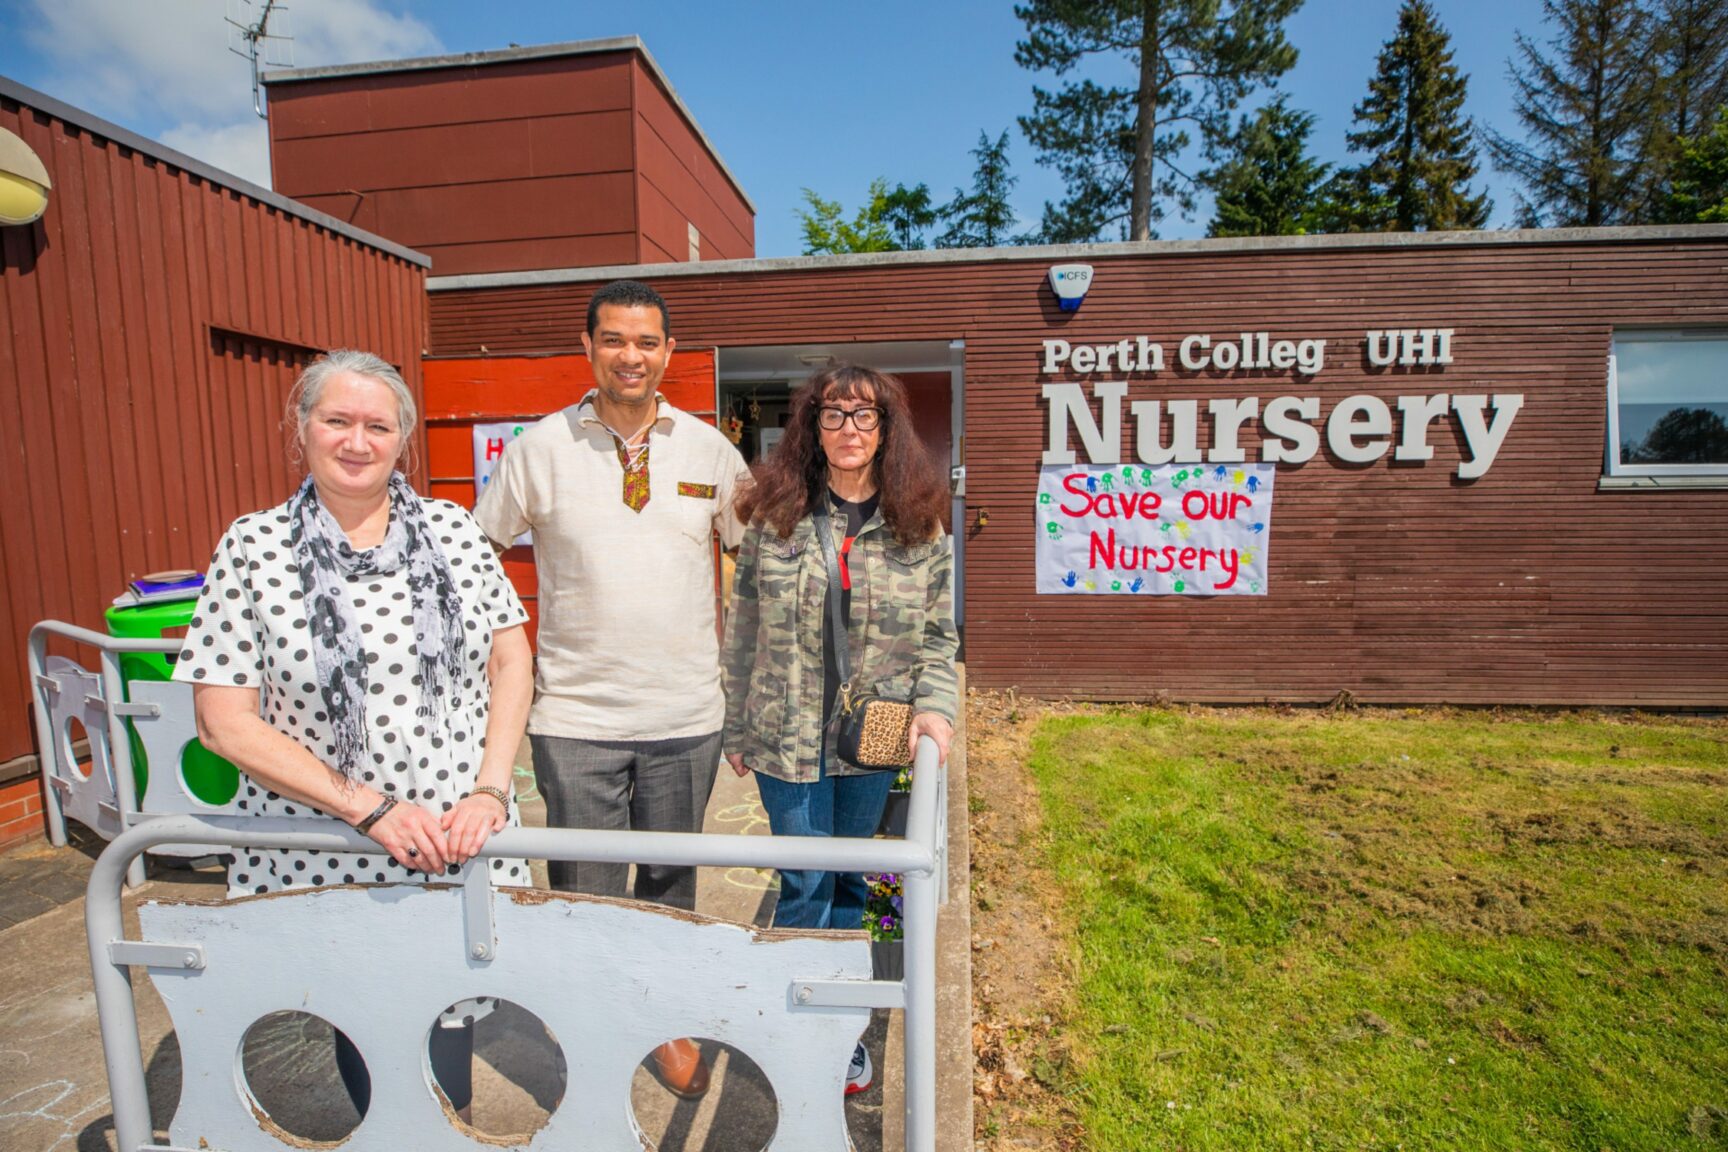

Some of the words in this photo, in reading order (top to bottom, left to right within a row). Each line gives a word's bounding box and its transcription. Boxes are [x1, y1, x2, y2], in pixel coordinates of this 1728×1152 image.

[1042, 335, 1165, 375] Perth
[1179, 332, 1327, 375] Colleg
[1366, 328, 1455, 367] UHI
[1041, 380, 1525, 480] Nursery
[1060, 473, 1162, 519] Save
[1088, 528, 1240, 591] Nursery
